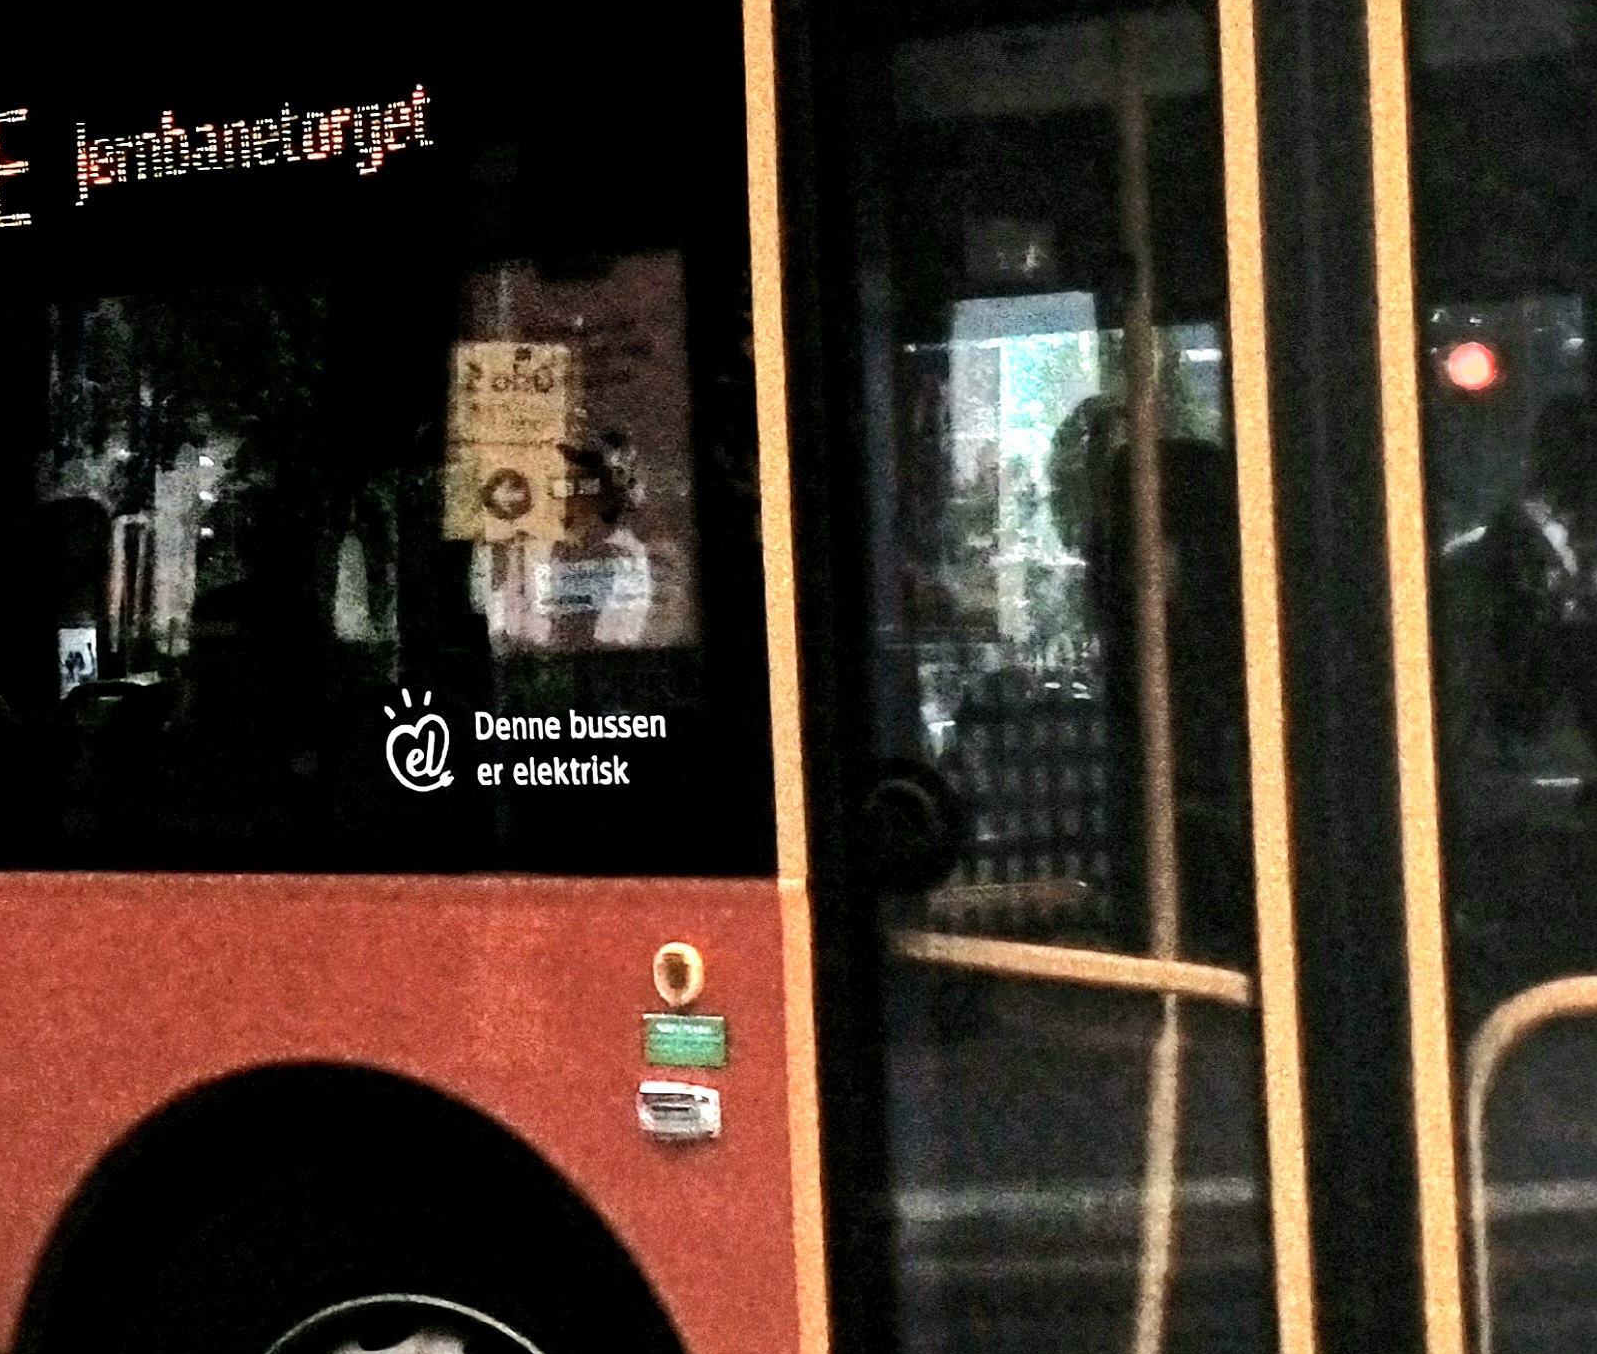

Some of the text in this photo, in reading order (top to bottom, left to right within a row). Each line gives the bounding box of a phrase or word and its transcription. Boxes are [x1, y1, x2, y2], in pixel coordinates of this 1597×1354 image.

[474, 708, 667, 741] Denne bussen
[476, 754, 631, 786] er elektrisk
